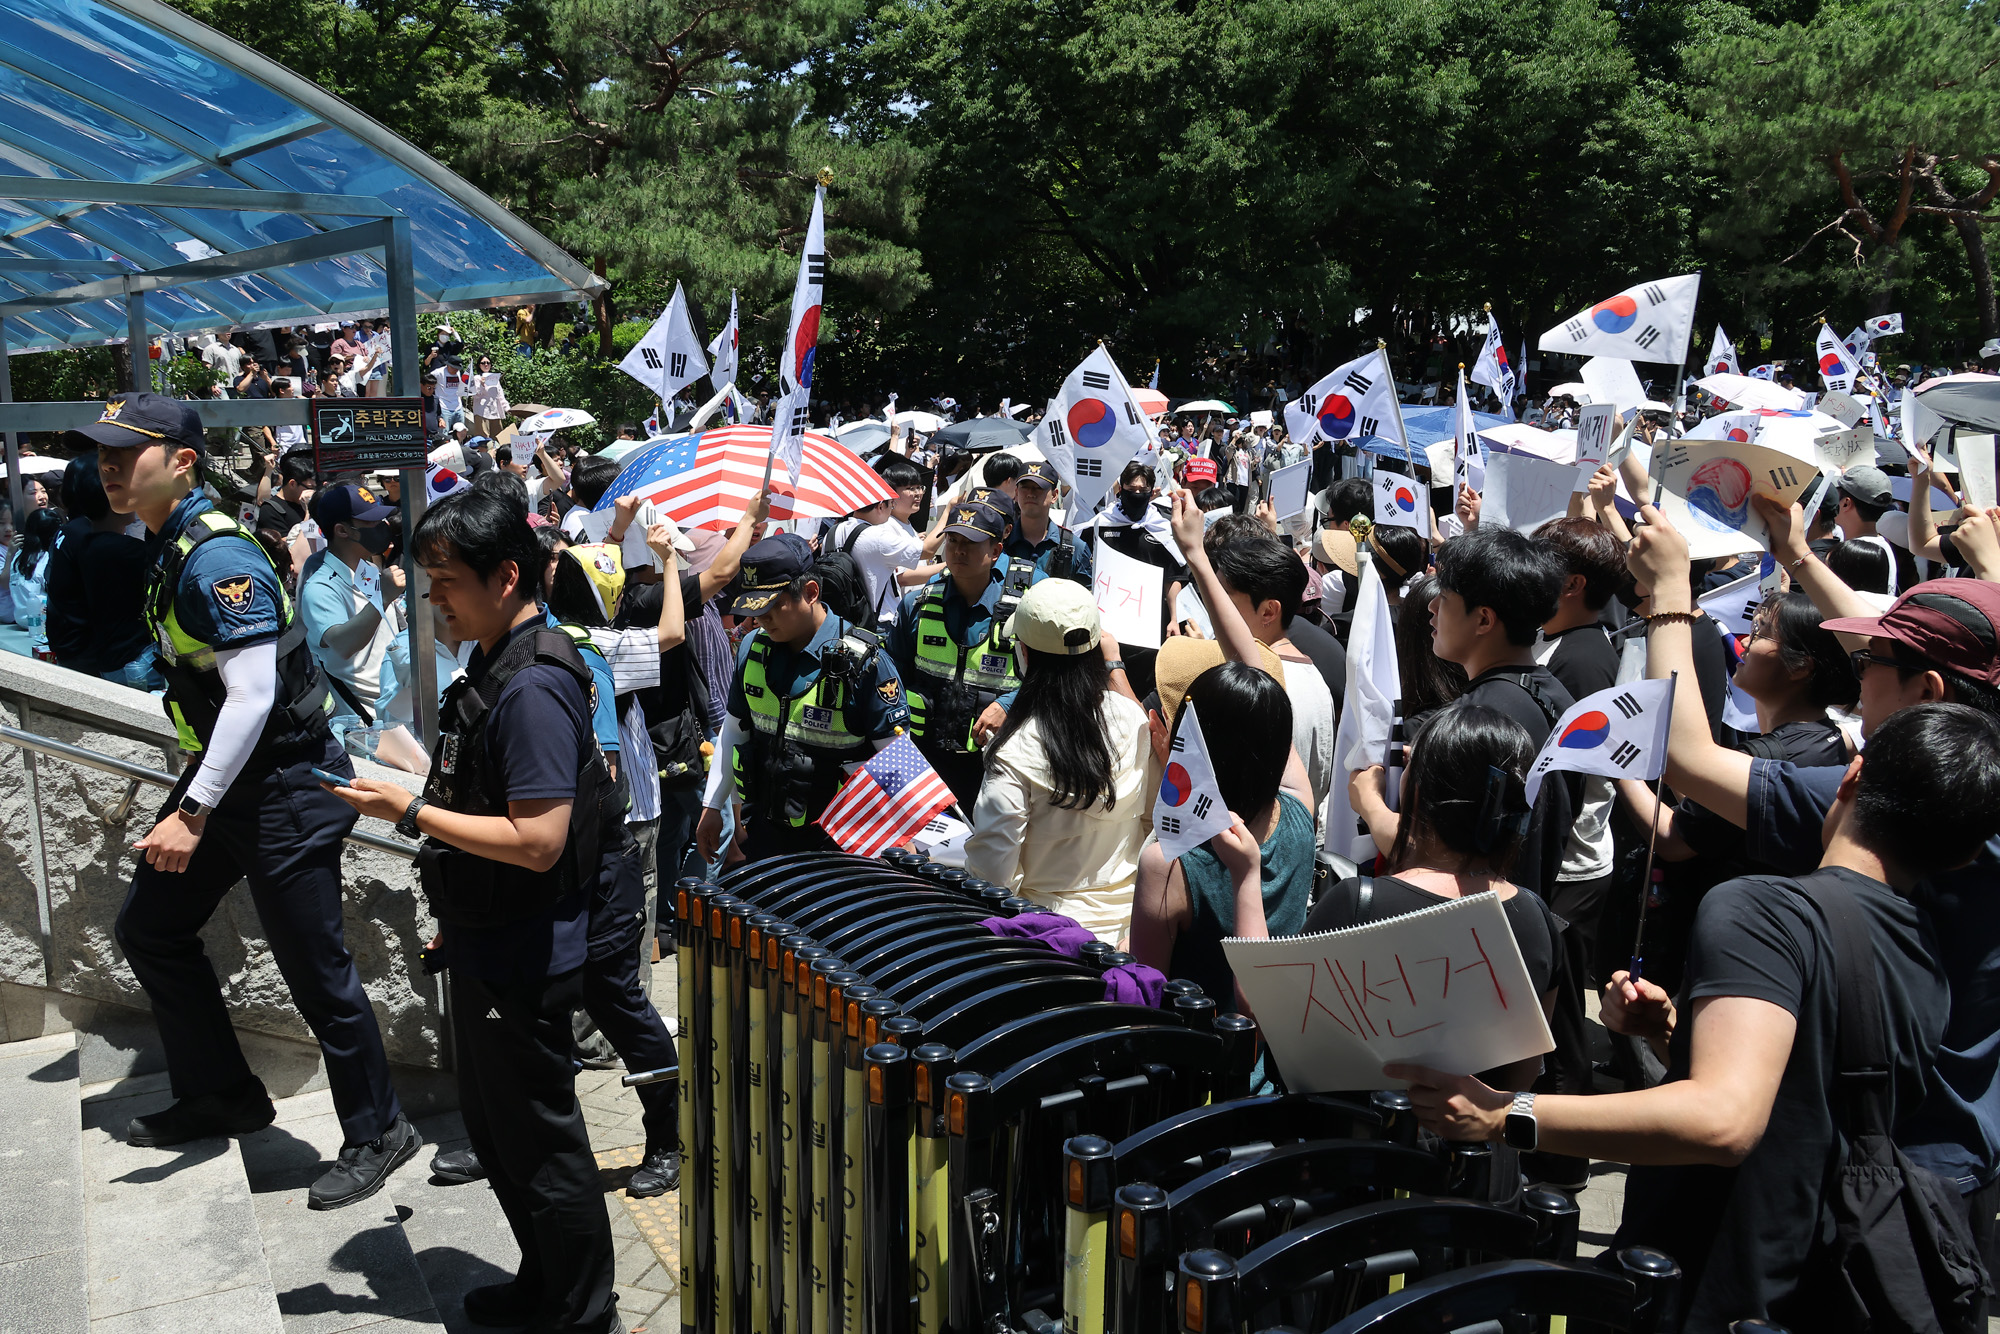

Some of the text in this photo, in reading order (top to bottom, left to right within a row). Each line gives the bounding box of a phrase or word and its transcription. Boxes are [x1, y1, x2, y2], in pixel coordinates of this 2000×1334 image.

[355, 409, 422, 429] 추락주의
[231, 600, 248, 608] POLICE
[981, 665, 1004, 674] POLICE
[804, 706, 831, 722] 경찰
[803, 719, 829, 730] POLICE
[1252, 926, 1509, 1041] 재선거
